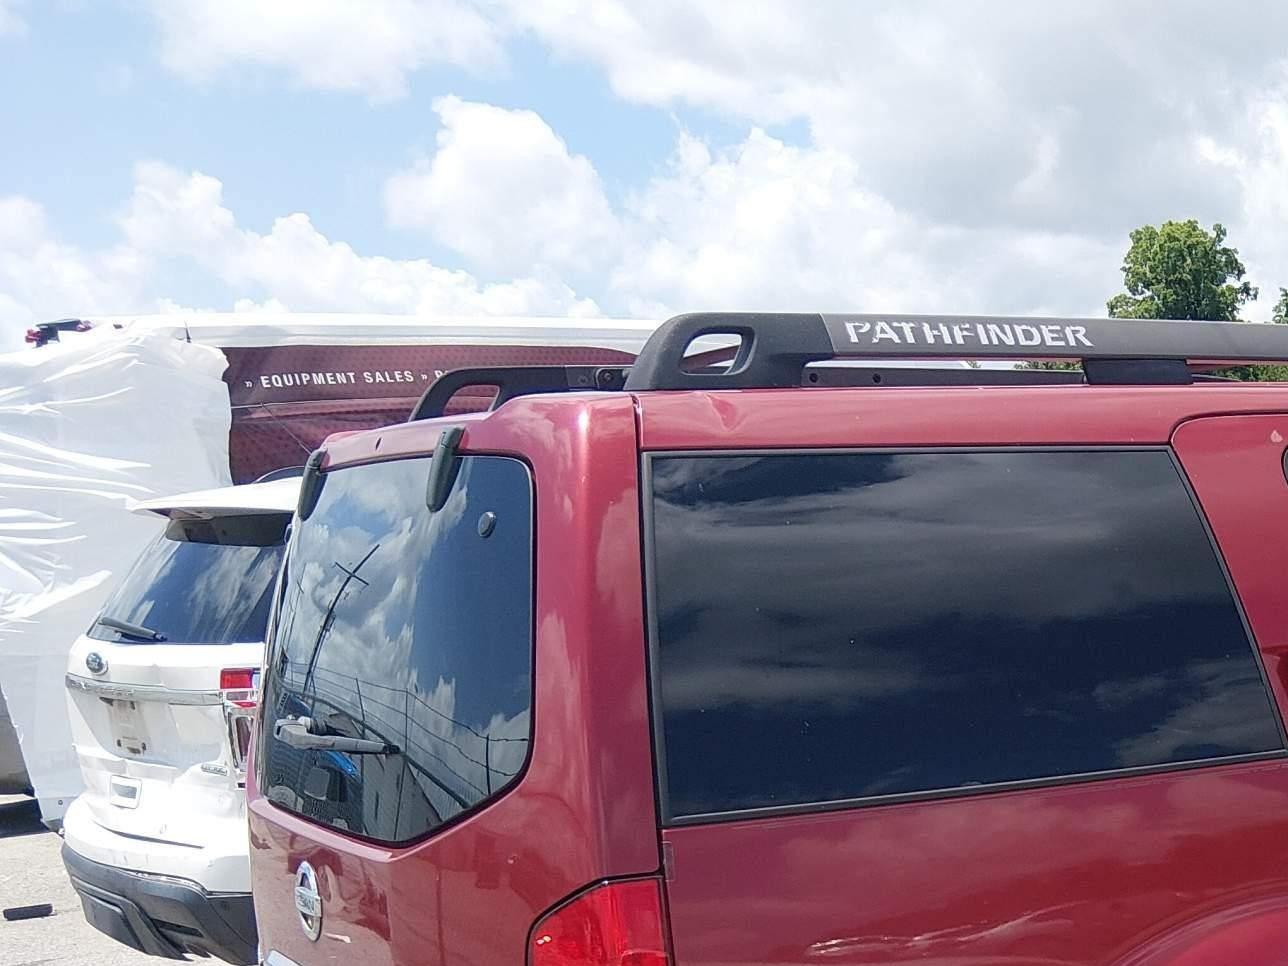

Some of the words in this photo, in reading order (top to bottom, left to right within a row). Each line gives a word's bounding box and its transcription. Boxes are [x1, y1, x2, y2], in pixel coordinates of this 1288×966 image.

[844, 320, 1094, 347] PATHFINDER
[260, 372, 356, 388] EQUIPMENT
[363, 370, 414, 384] SALES
